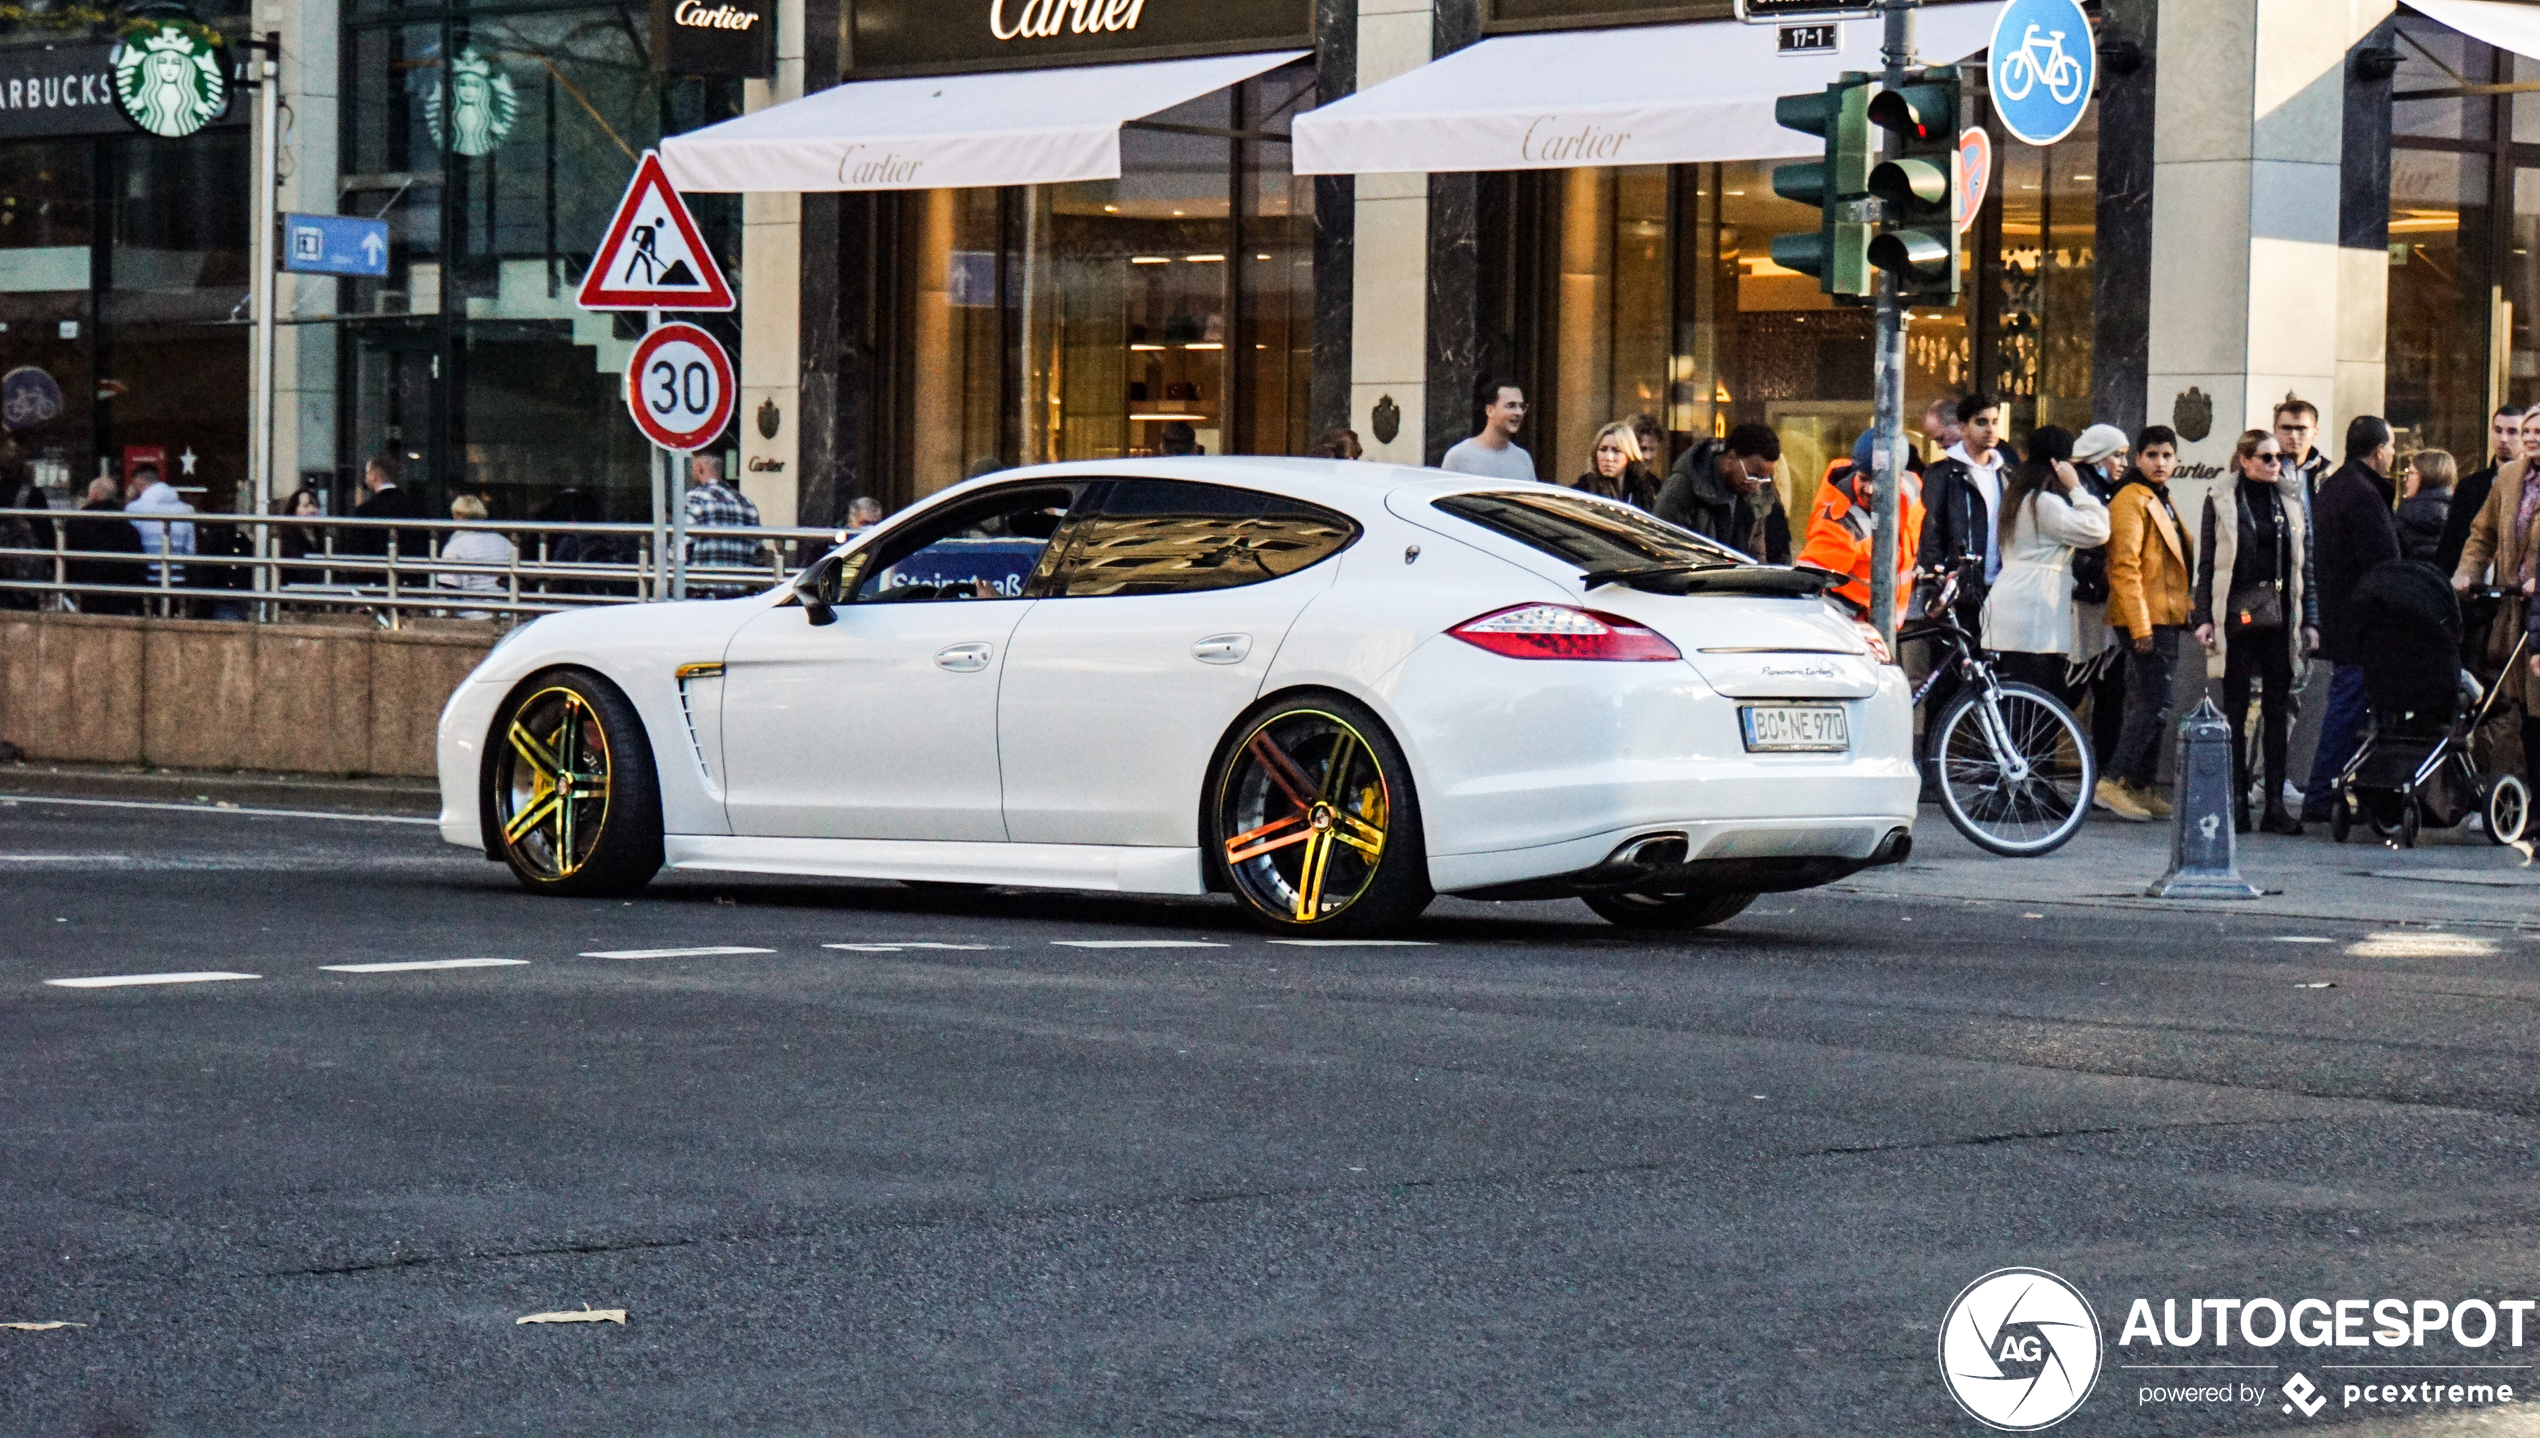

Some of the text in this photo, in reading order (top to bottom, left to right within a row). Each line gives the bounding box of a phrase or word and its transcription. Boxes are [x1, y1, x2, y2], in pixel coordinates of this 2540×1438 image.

[674, 0, 759, 31] Cartier
[1792, 28, 1823, 48] 17-1
[1522, 113, 1631, 161] Cartier
[837, 142, 923, 184] Cartier
[652, 361, 709, 414] 30
[2171, 459, 2225, 479] artier
[1756, 712, 1844, 740] BO NE 970
